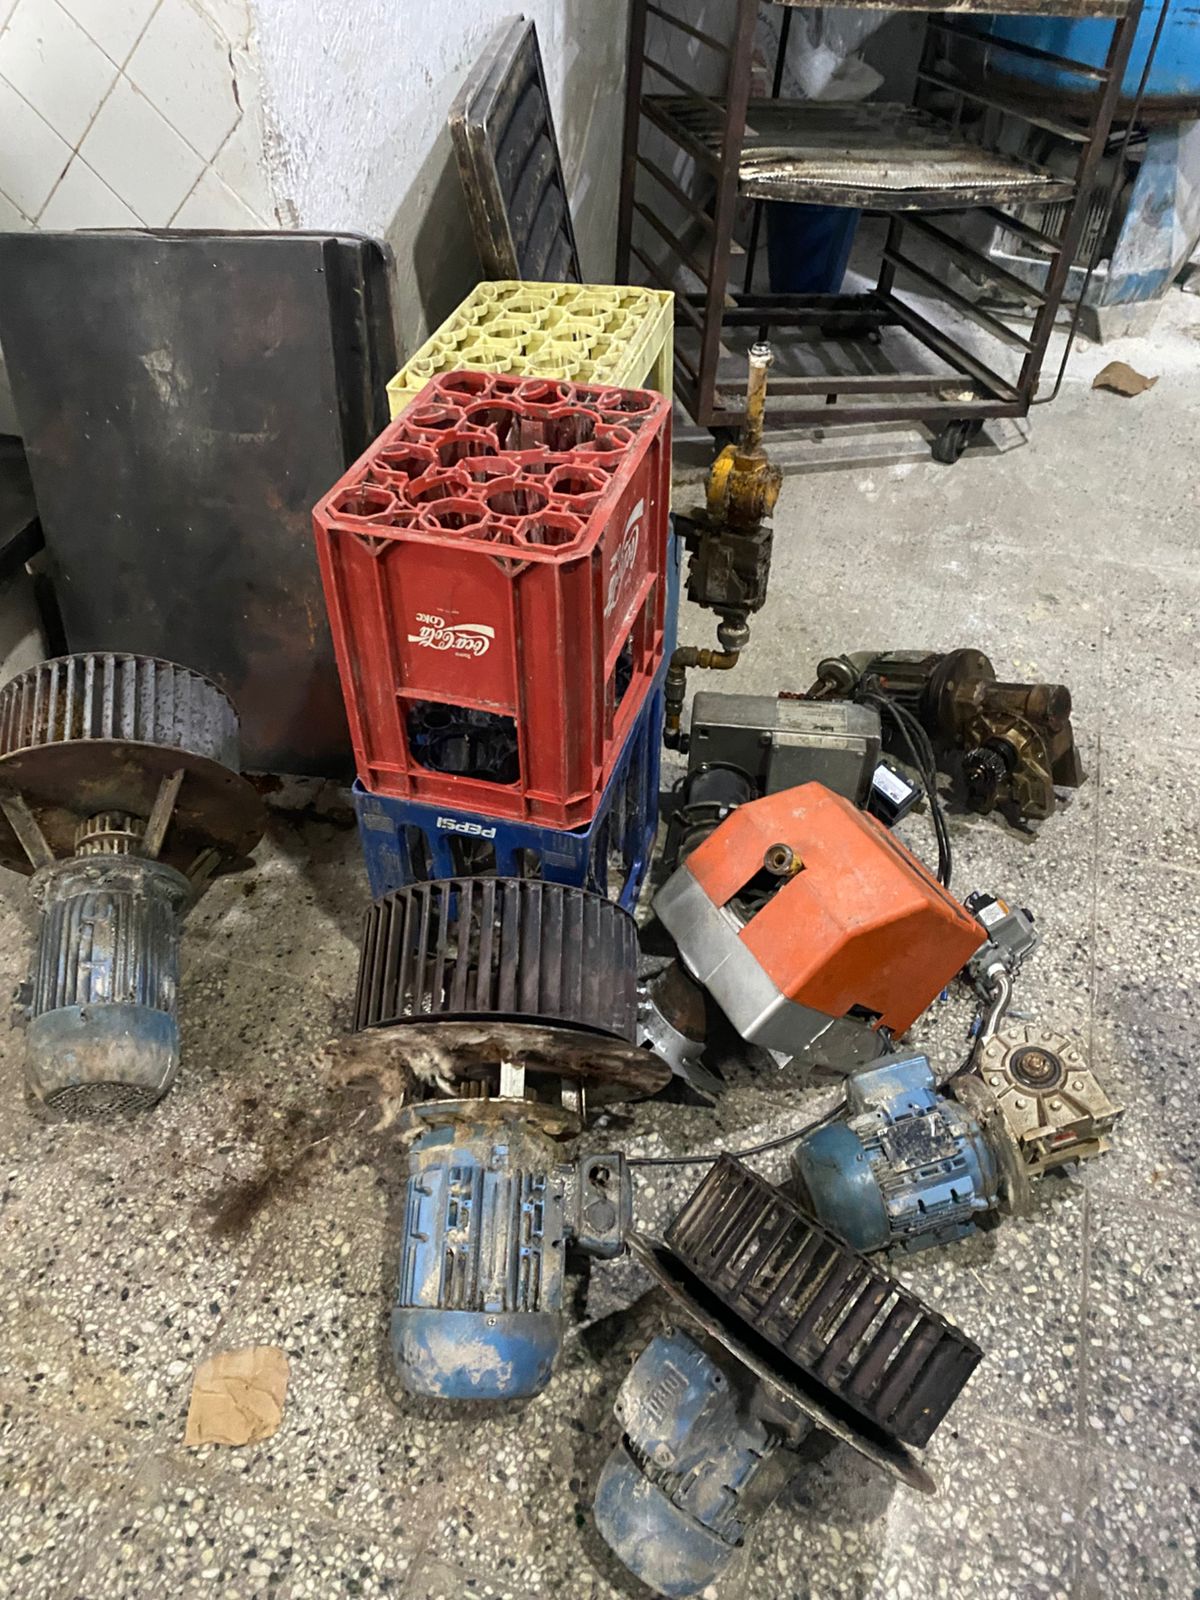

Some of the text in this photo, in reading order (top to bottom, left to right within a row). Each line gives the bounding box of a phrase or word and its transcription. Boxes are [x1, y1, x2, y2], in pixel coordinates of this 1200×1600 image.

[416, 612, 445, 629] Coke
[412, 625, 491, 657] Coca-Cola
[436, 816, 497, 839] PEPSI
